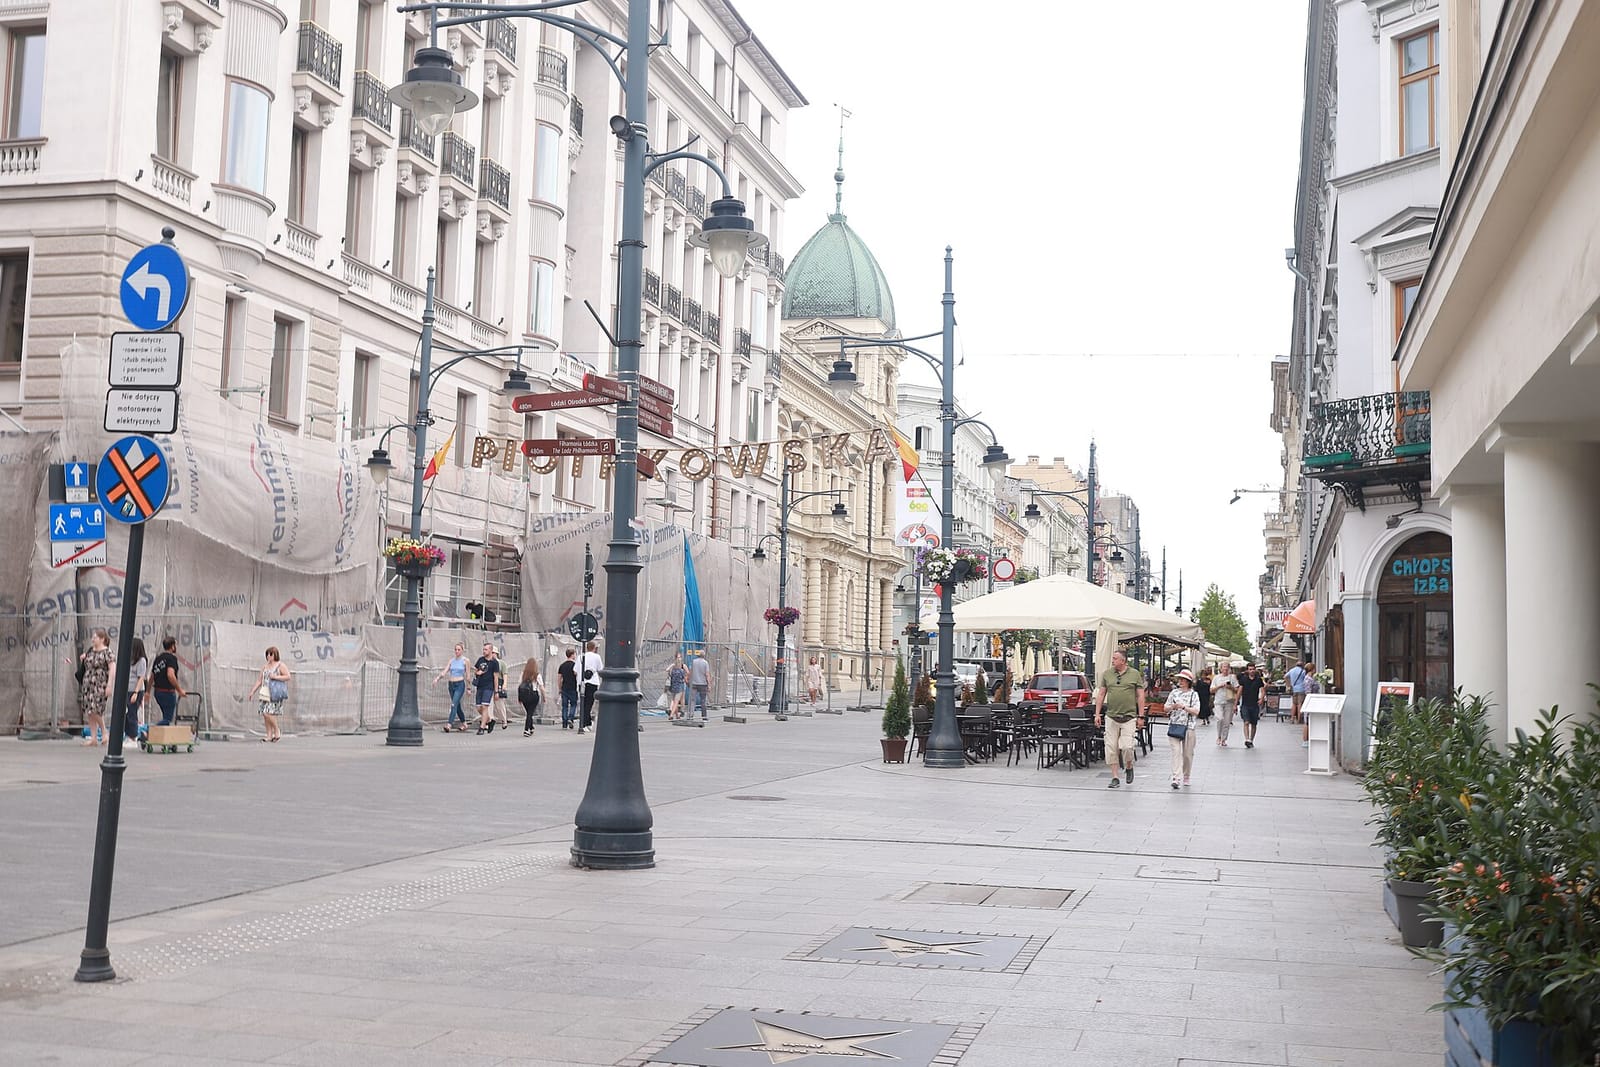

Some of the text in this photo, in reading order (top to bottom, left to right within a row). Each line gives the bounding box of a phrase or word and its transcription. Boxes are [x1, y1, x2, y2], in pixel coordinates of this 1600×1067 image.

[135, 393, 160, 402] dotyczy
[116, 417, 161, 426] elektrycznych
[254, 422, 285, 554] remmers
[24, 583, 154, 628] remmes
